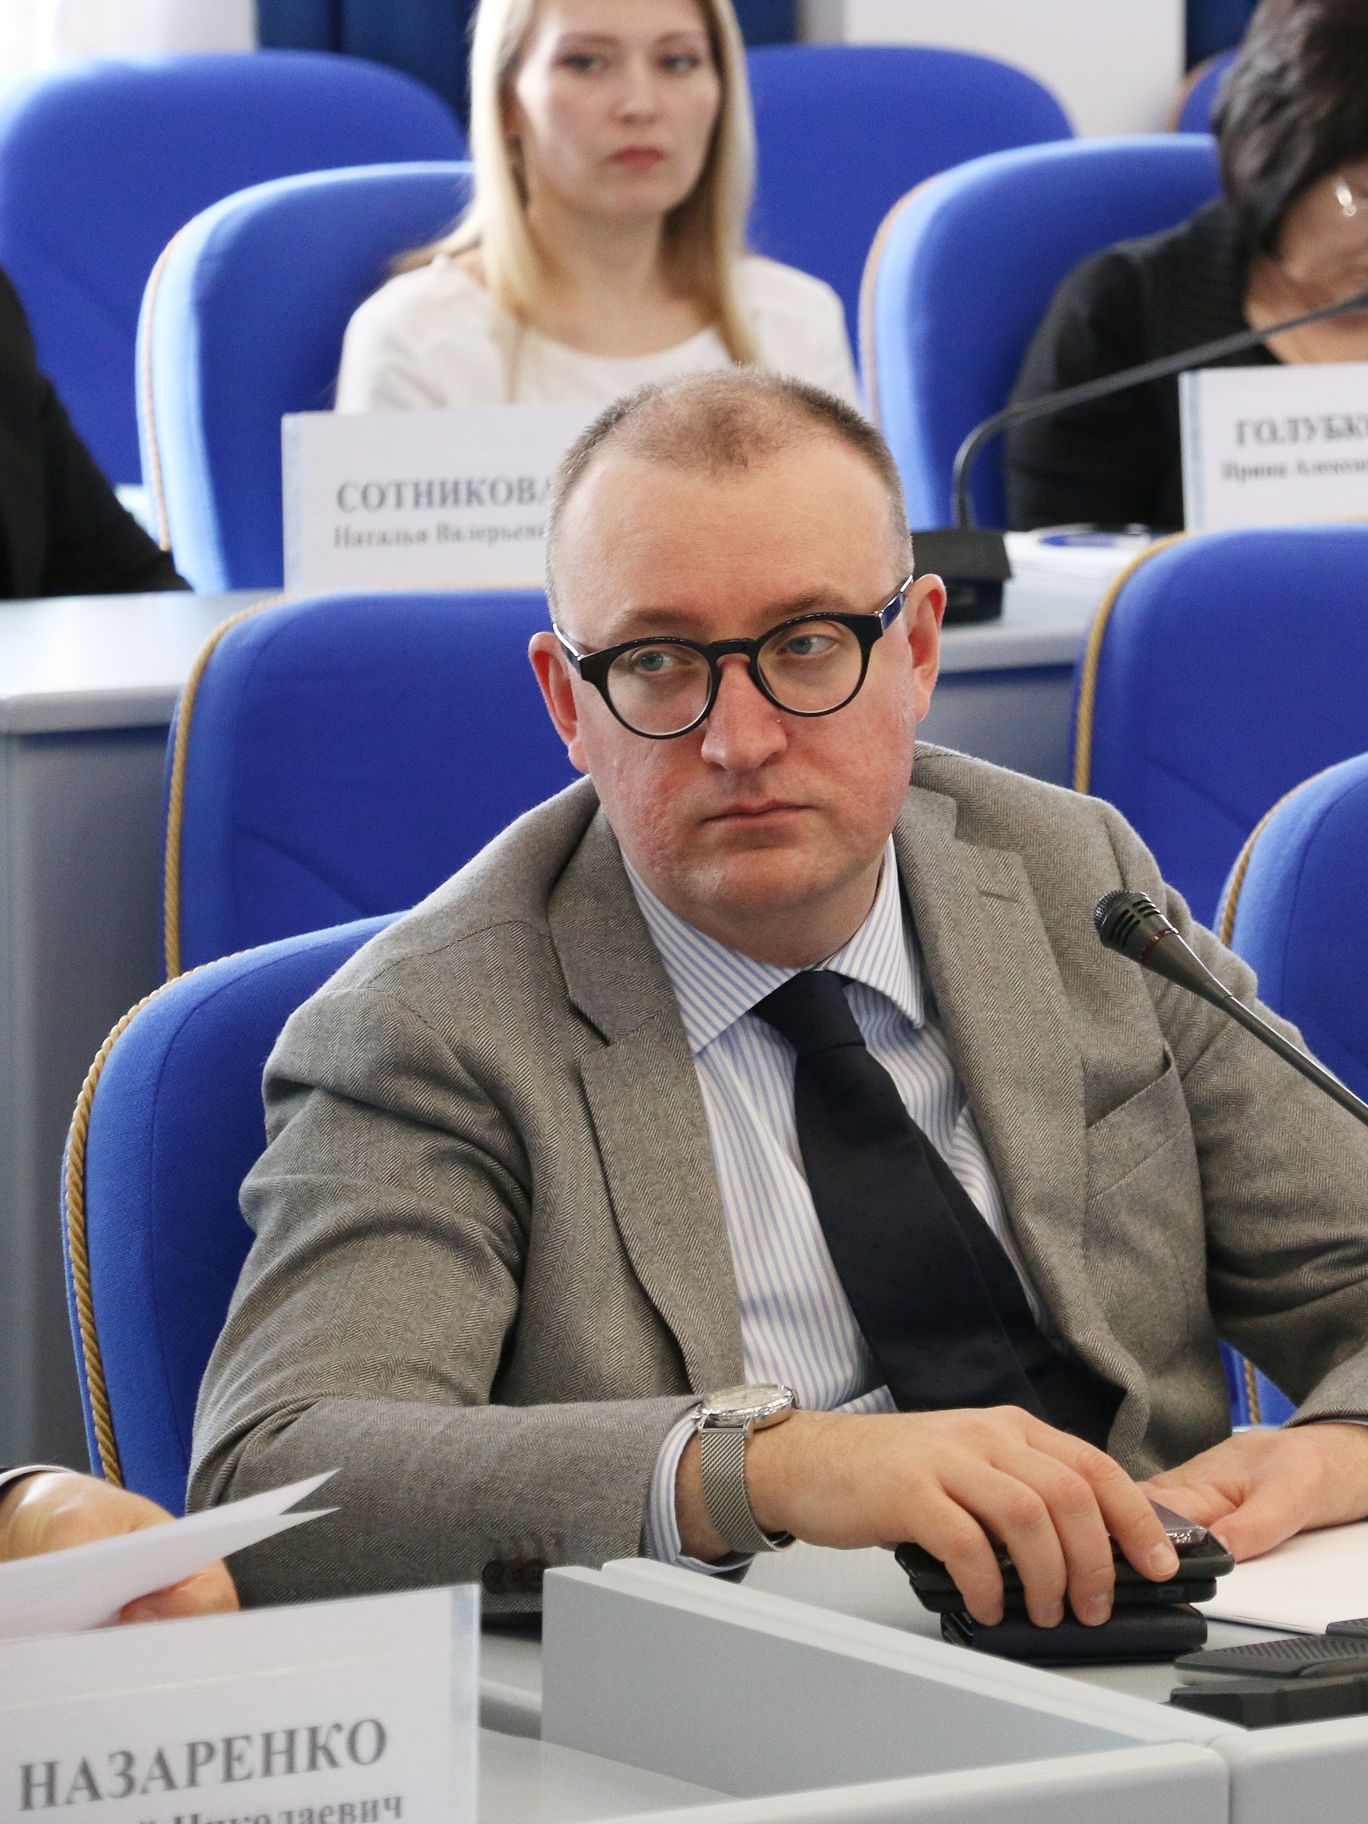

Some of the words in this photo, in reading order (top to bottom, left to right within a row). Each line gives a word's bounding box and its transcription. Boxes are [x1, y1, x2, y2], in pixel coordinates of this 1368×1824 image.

[336, 476, 551, 512] СОТНИКОВ
[334, 525, 428, 549] Наталья
[18, 1717, 389, 1812] НАЗАРЕНКО
[172, 1795, 404, 1824] лаевич
